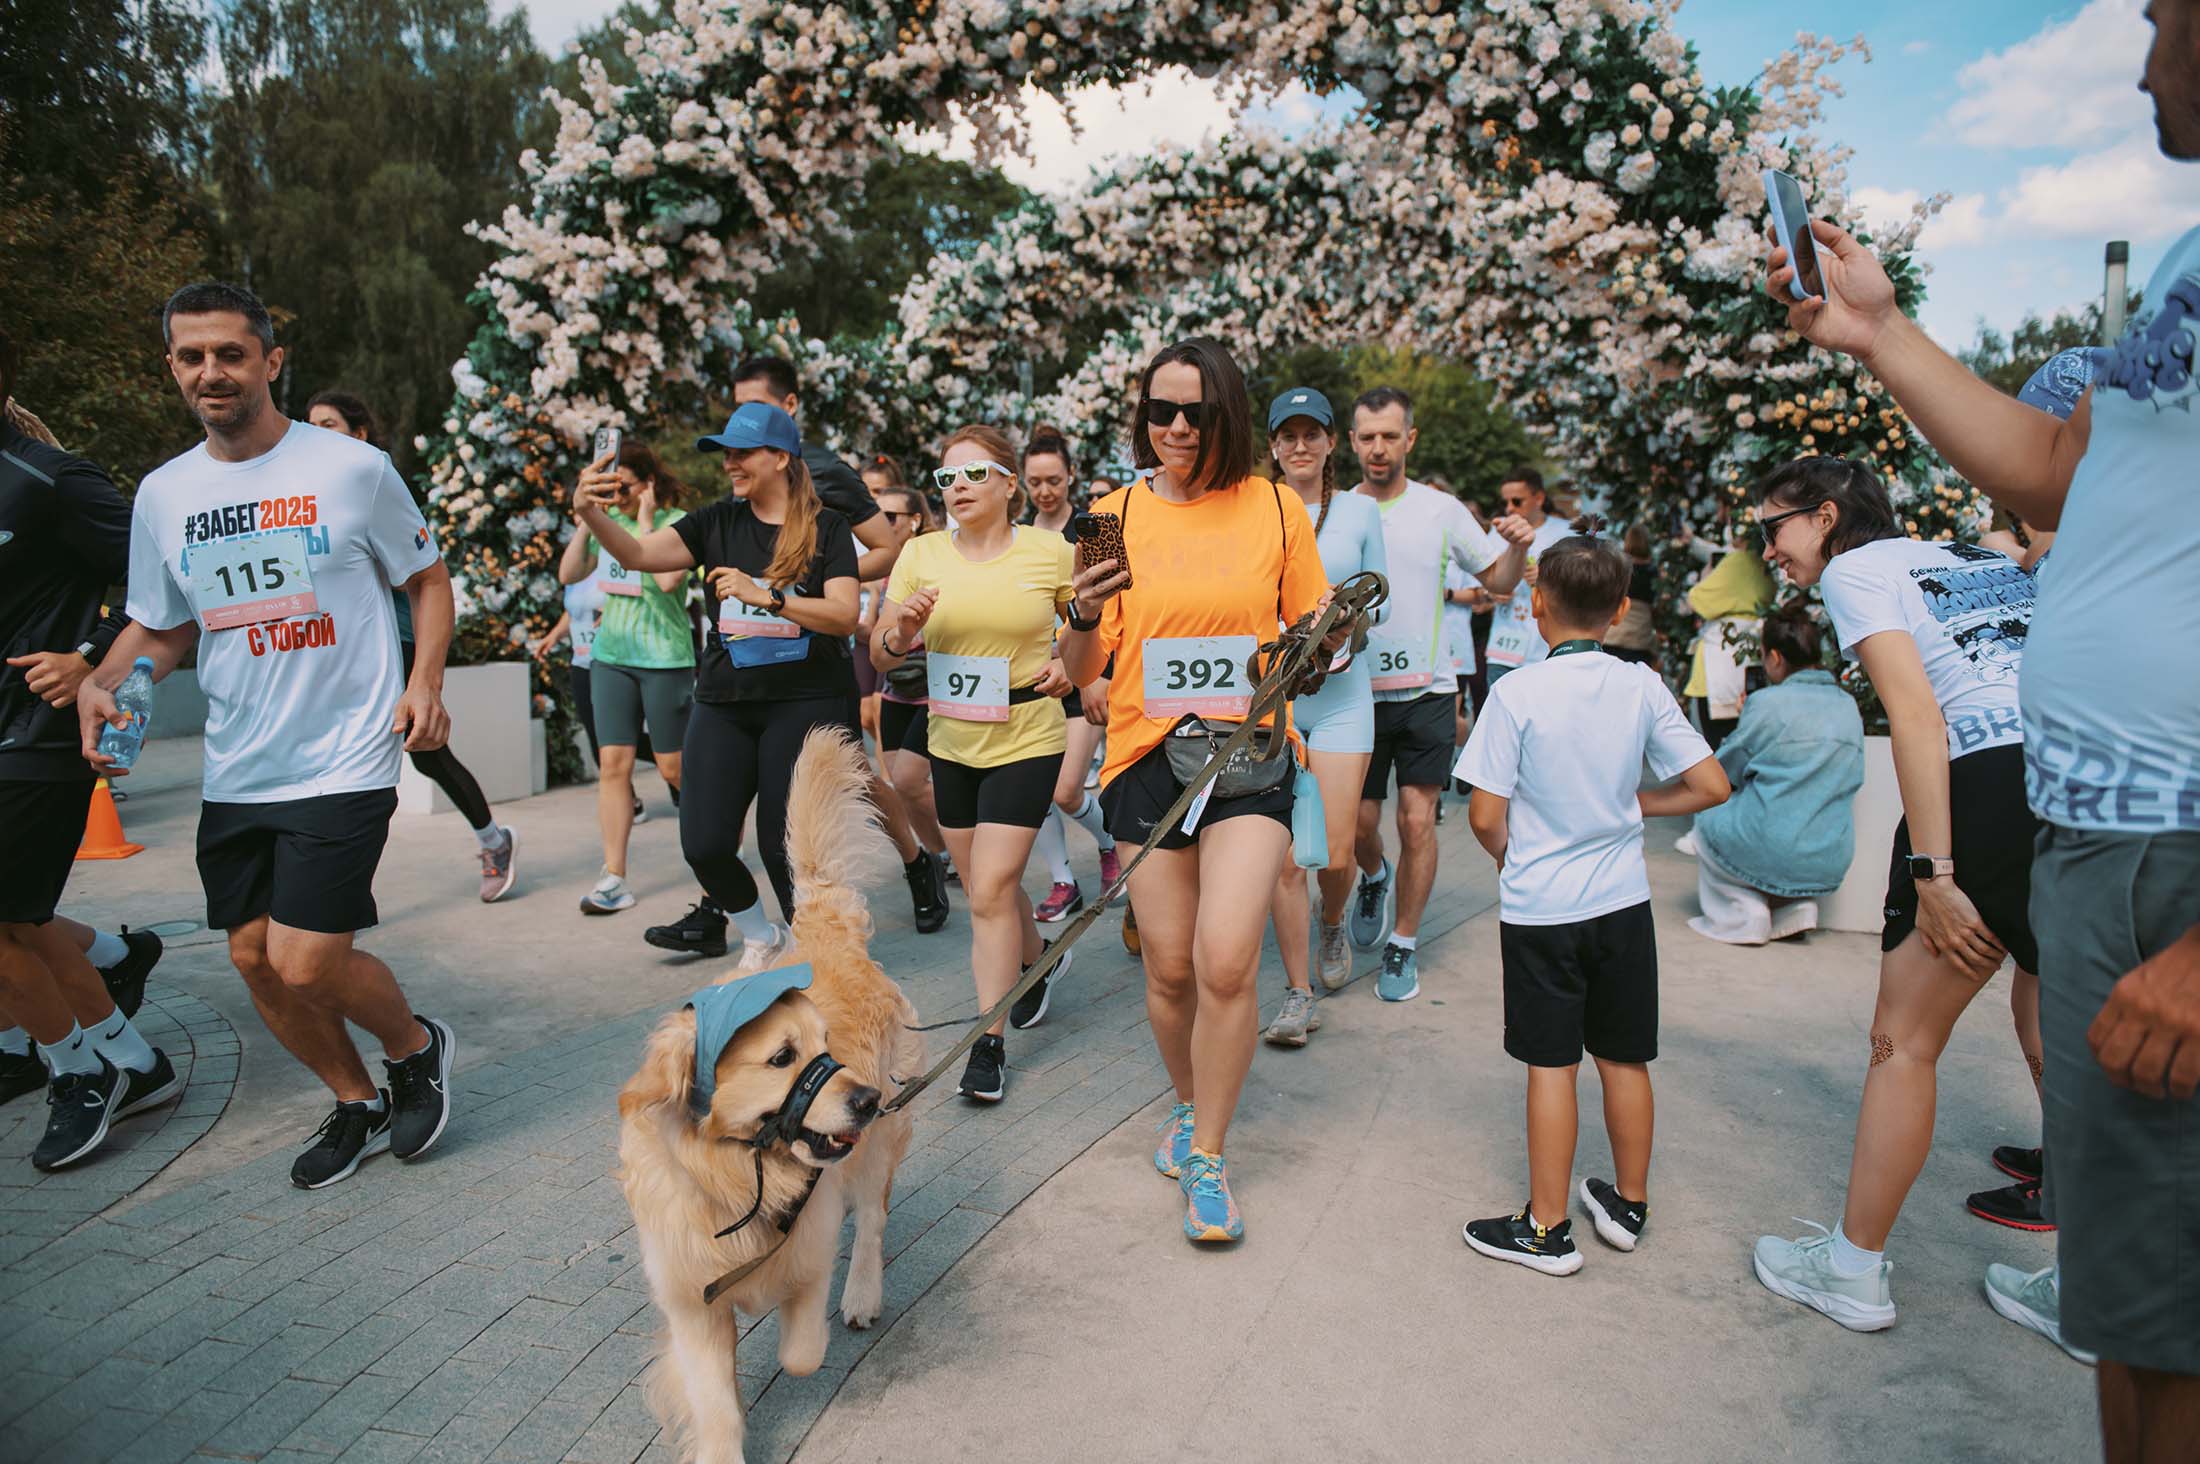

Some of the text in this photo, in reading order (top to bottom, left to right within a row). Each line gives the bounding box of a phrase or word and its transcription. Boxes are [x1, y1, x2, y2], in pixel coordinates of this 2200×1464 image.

[184, 495, 318, 545] #ЗАБЕГ2025
[215, 557, 285, 597] 115
[264, 612, 336, 652] ТОБОЙ
[1497, 636, 1520, 650] 417
[1166, 658, 1235, 690] 392
[1379, 650, 1409, 671] 36
[948, 673, 981, 698] 97
